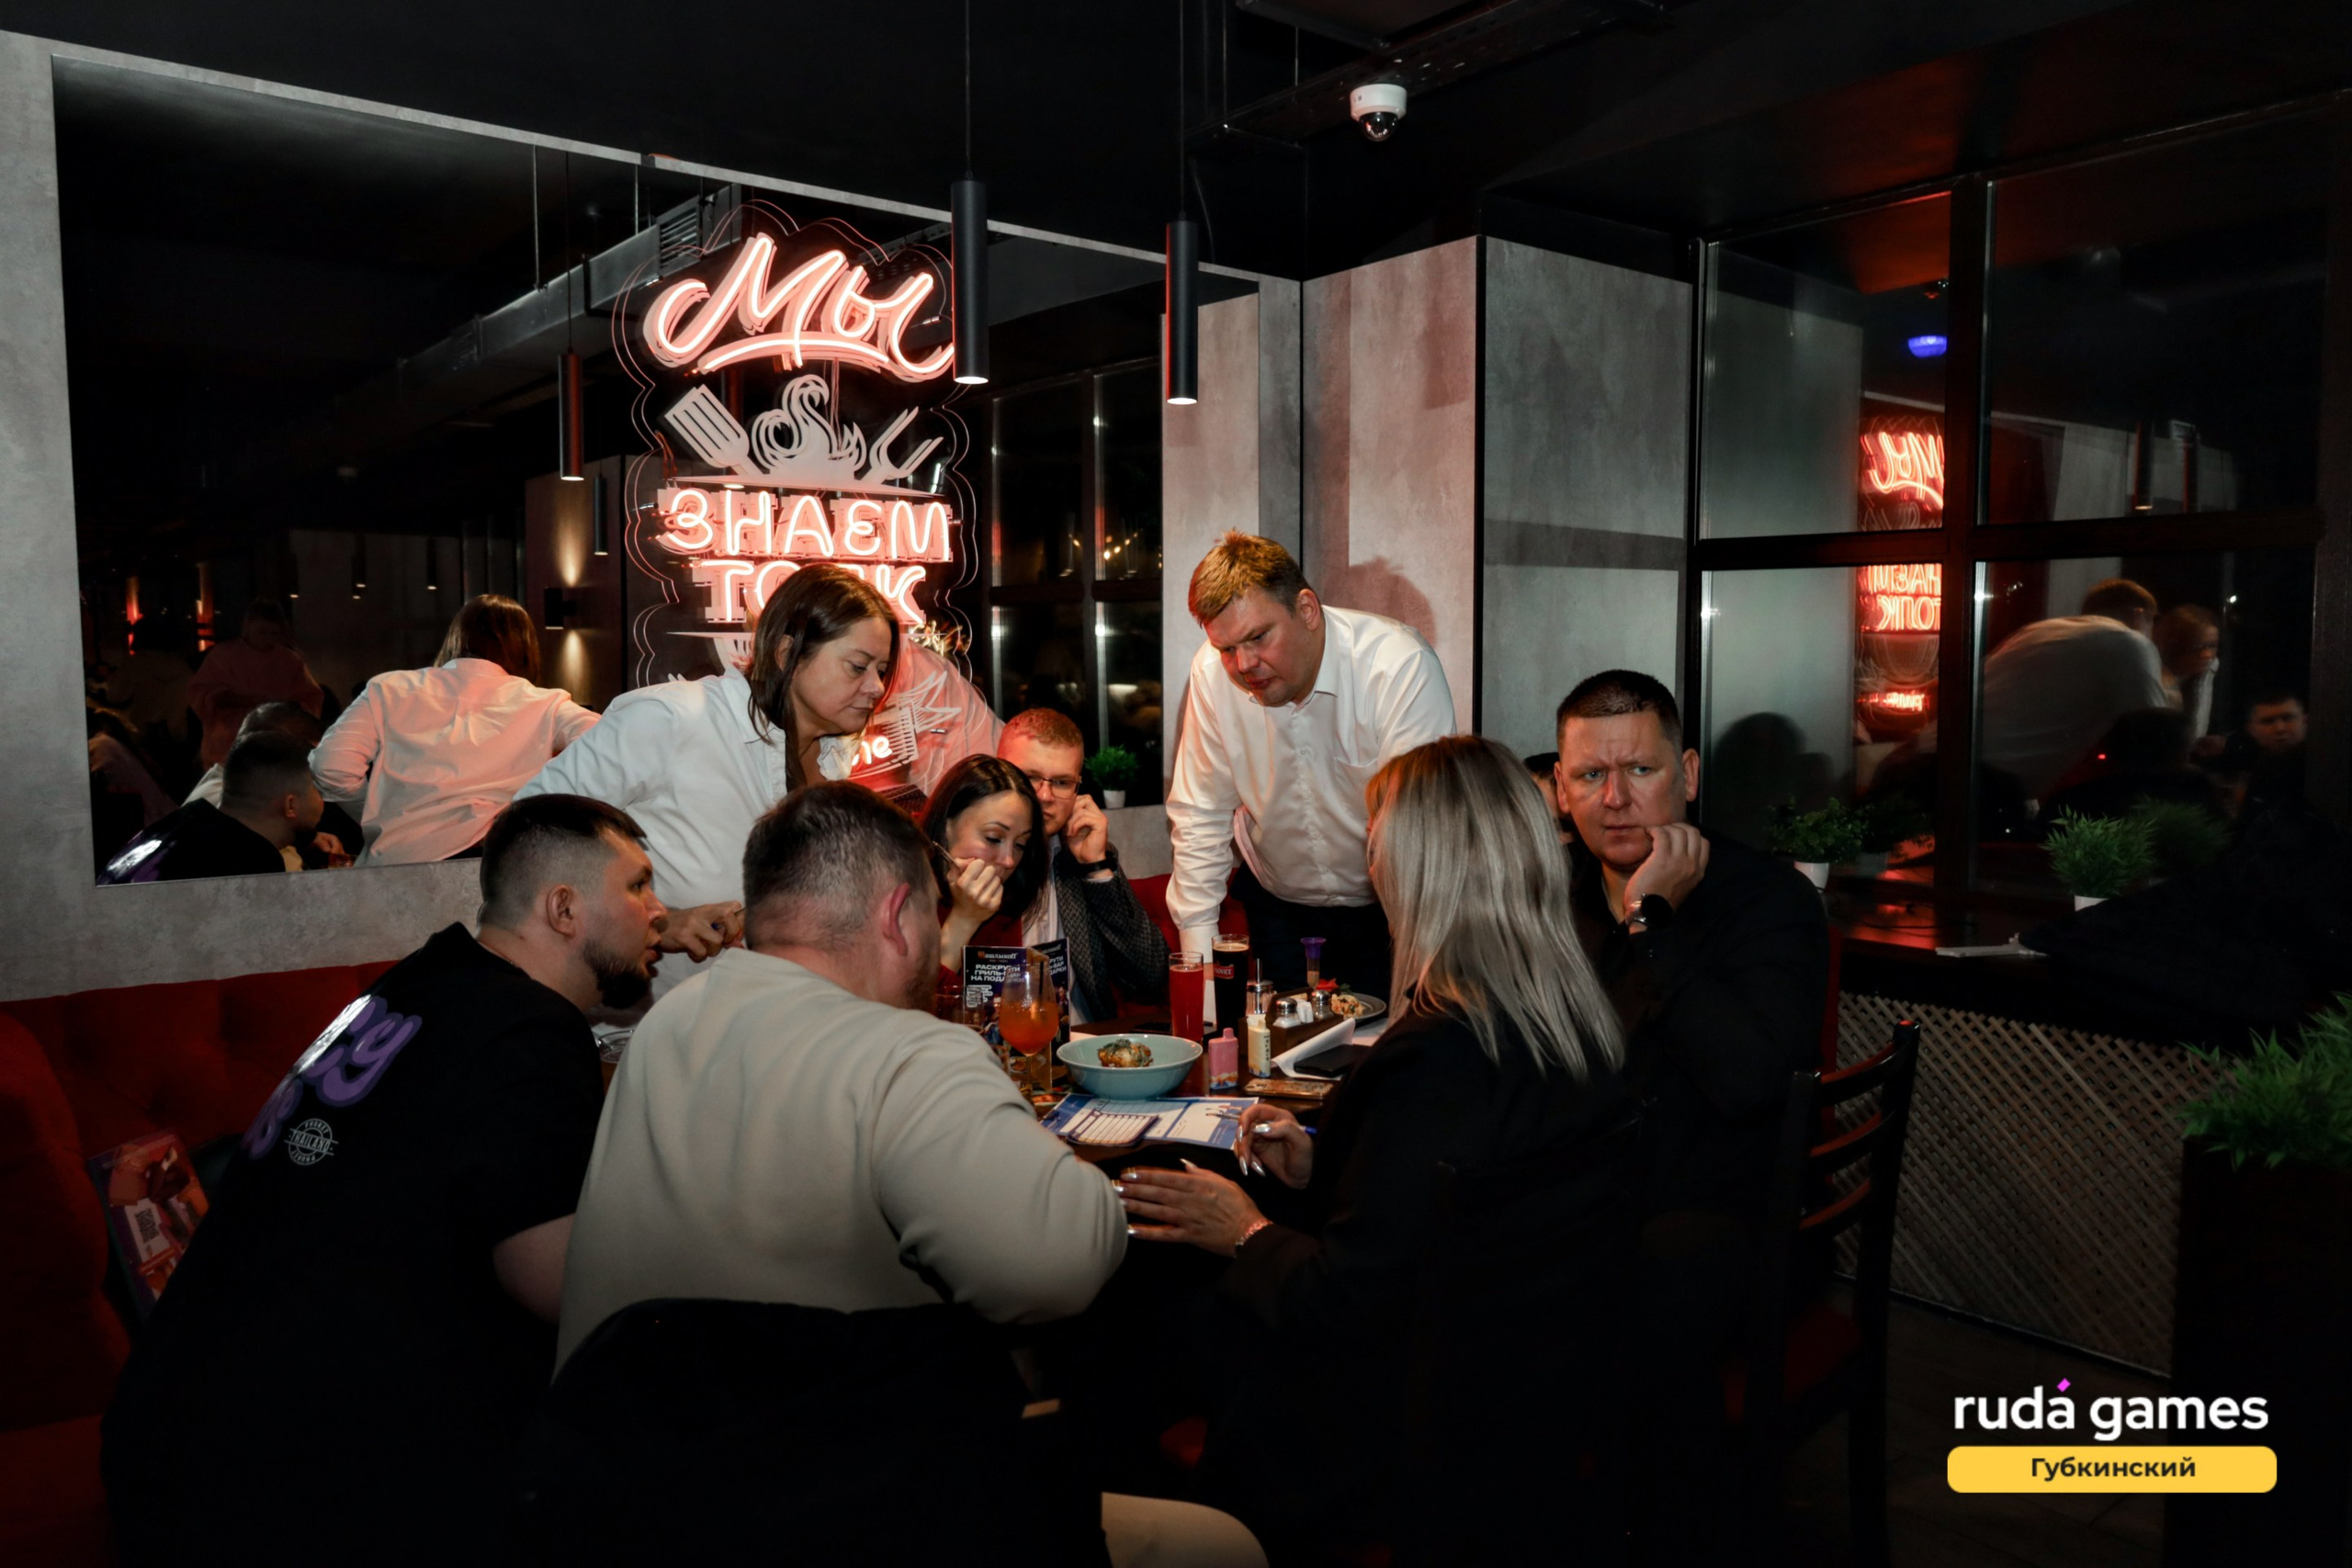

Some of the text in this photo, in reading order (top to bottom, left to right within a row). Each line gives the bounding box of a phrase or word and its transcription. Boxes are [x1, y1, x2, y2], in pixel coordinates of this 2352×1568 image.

[645, 232, 955, 382] Мы
[657, 487, 953, 563] ЗНАЕМ
[290, 1130, 331, 1152] THAILAND
